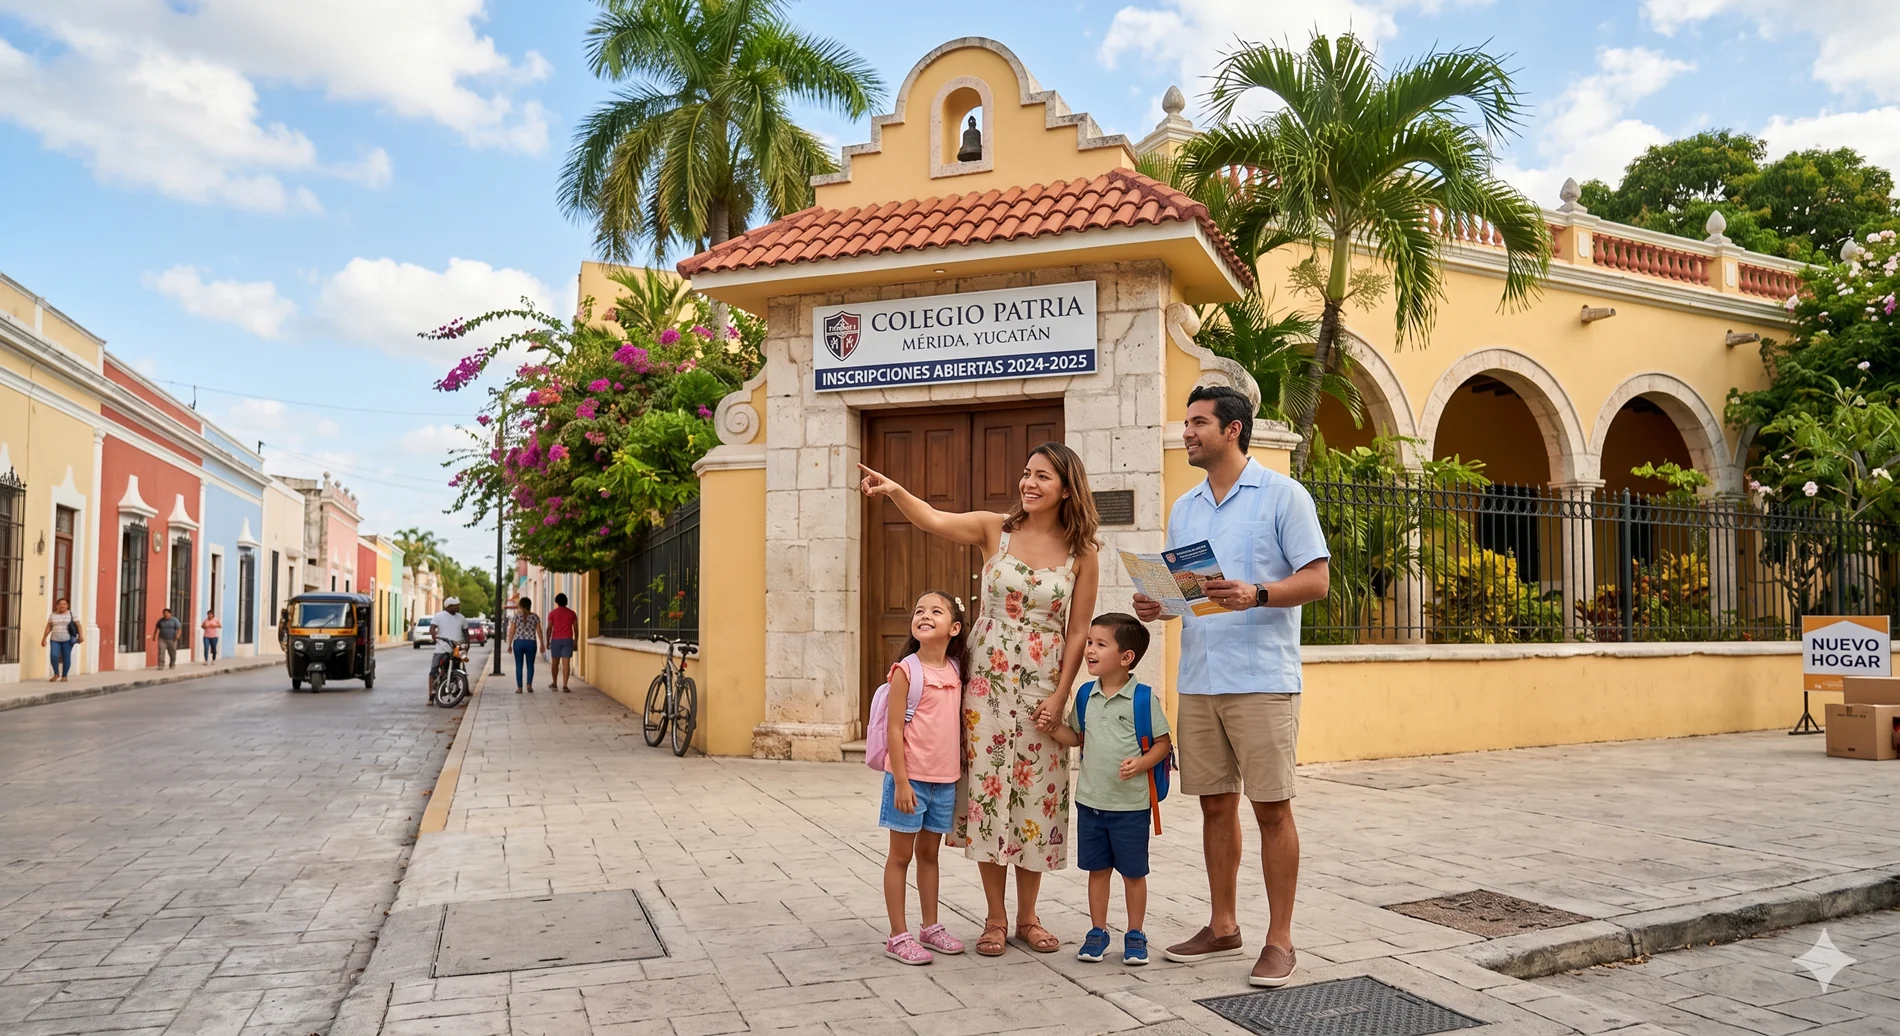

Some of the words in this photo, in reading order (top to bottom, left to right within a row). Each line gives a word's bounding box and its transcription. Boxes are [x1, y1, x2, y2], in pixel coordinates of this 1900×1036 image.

[872, 305, 984, 332] COLEGIO
[993, 296, 1084, 323] PATRIA
[902, 333, 969, 351] MÉRIDA,
[974, 325, 1050, 345] YUCATÁN
[822, 365, 931, 386] INSCRIPCIONES
[933, 360, 1004, 379] ABIERTAS
[1007, 354, 1088, 374] 2024-2025
[1812, 638, 1880, 652] NUEVO
[1812, 654, 1880, 668] HOGAR
